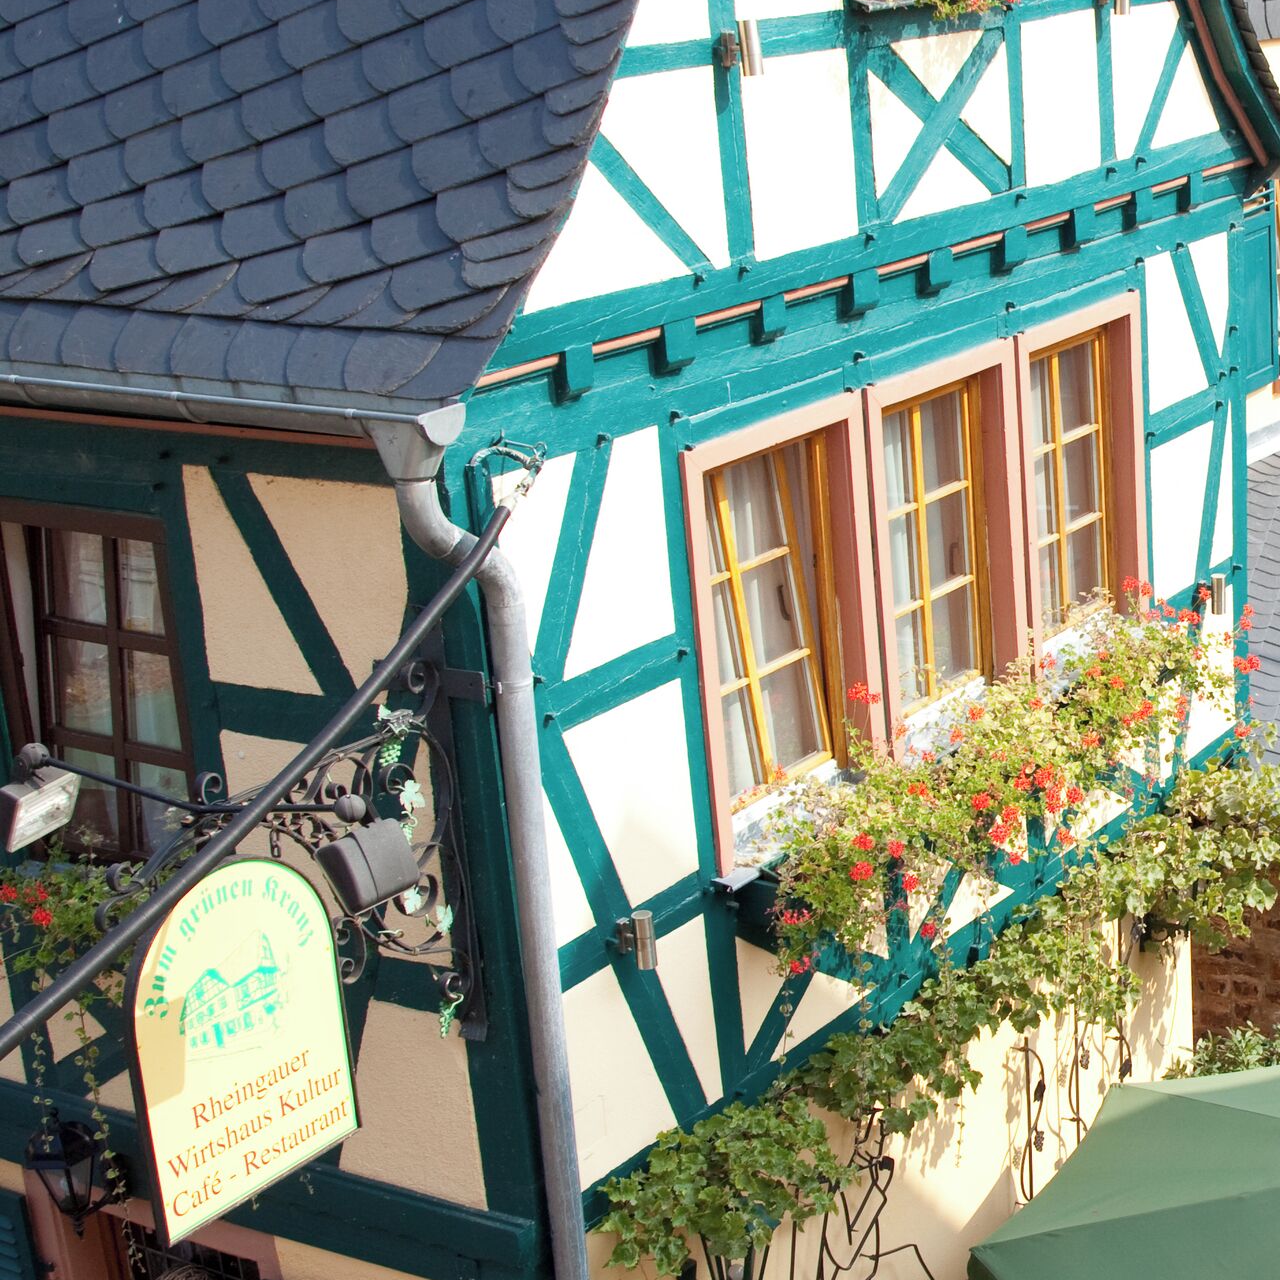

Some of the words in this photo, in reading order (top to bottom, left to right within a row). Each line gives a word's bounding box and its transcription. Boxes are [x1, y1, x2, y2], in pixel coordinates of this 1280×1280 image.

[143, 943, 179, 1021] Zum
[181, 878, 254, 946] grünen
[261, 874, 316, 950] Kranz
[167, 1109, 273, 1181] Wirtshaus
[279, 1068, 342, 1120] Kultur
[191, 1049, 310, 1130] Rheingauer
[172, 1168, 225, 1219] Café
[243, 1099, 350, 1178] Restaurant
